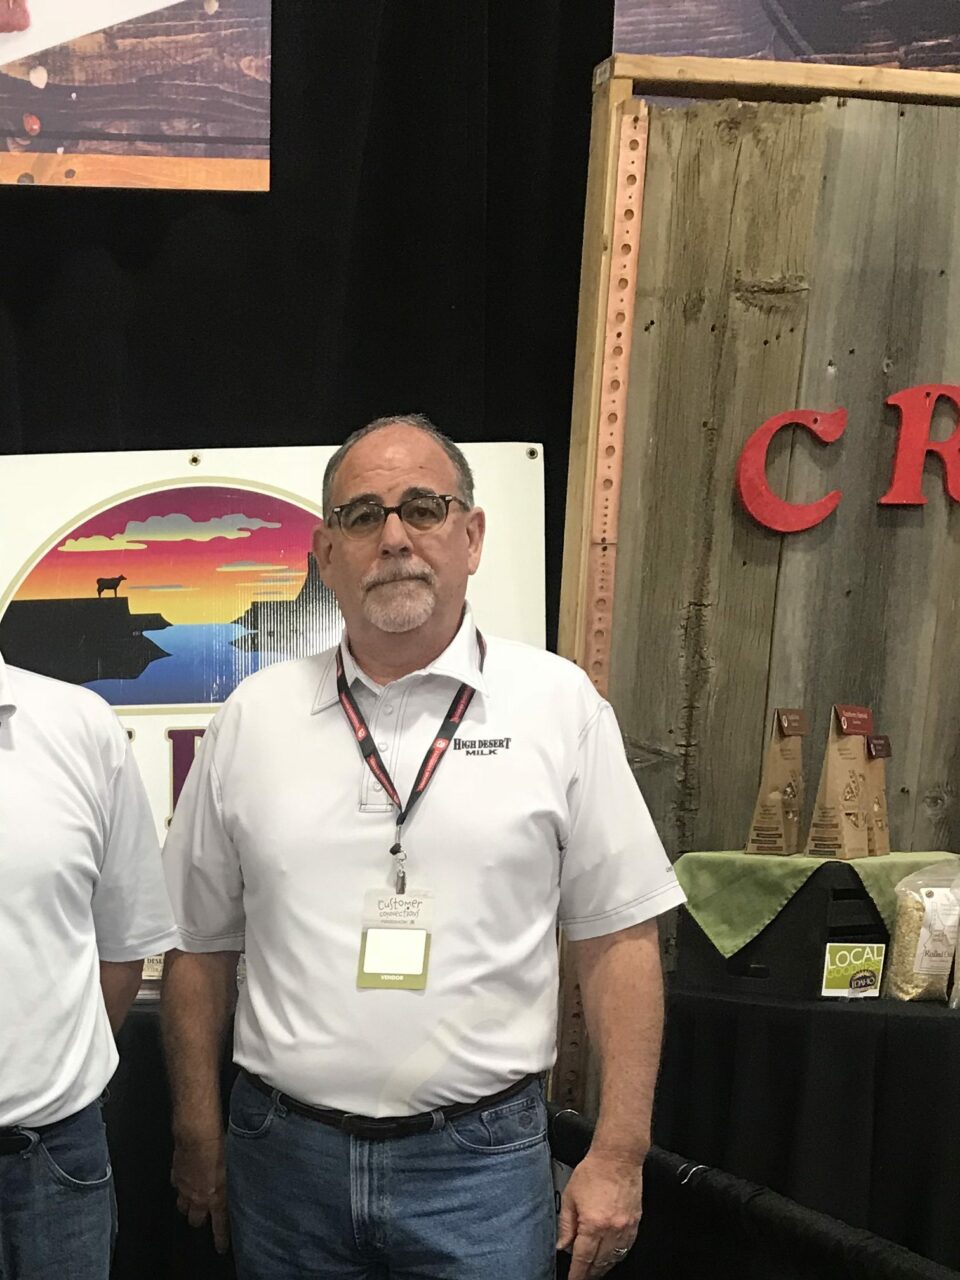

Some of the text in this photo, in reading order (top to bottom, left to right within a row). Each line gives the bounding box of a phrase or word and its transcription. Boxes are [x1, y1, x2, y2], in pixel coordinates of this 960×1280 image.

[453, 737, 512, 750] HIGH DESERT
[826, 945, 883, 969] LOCAL
